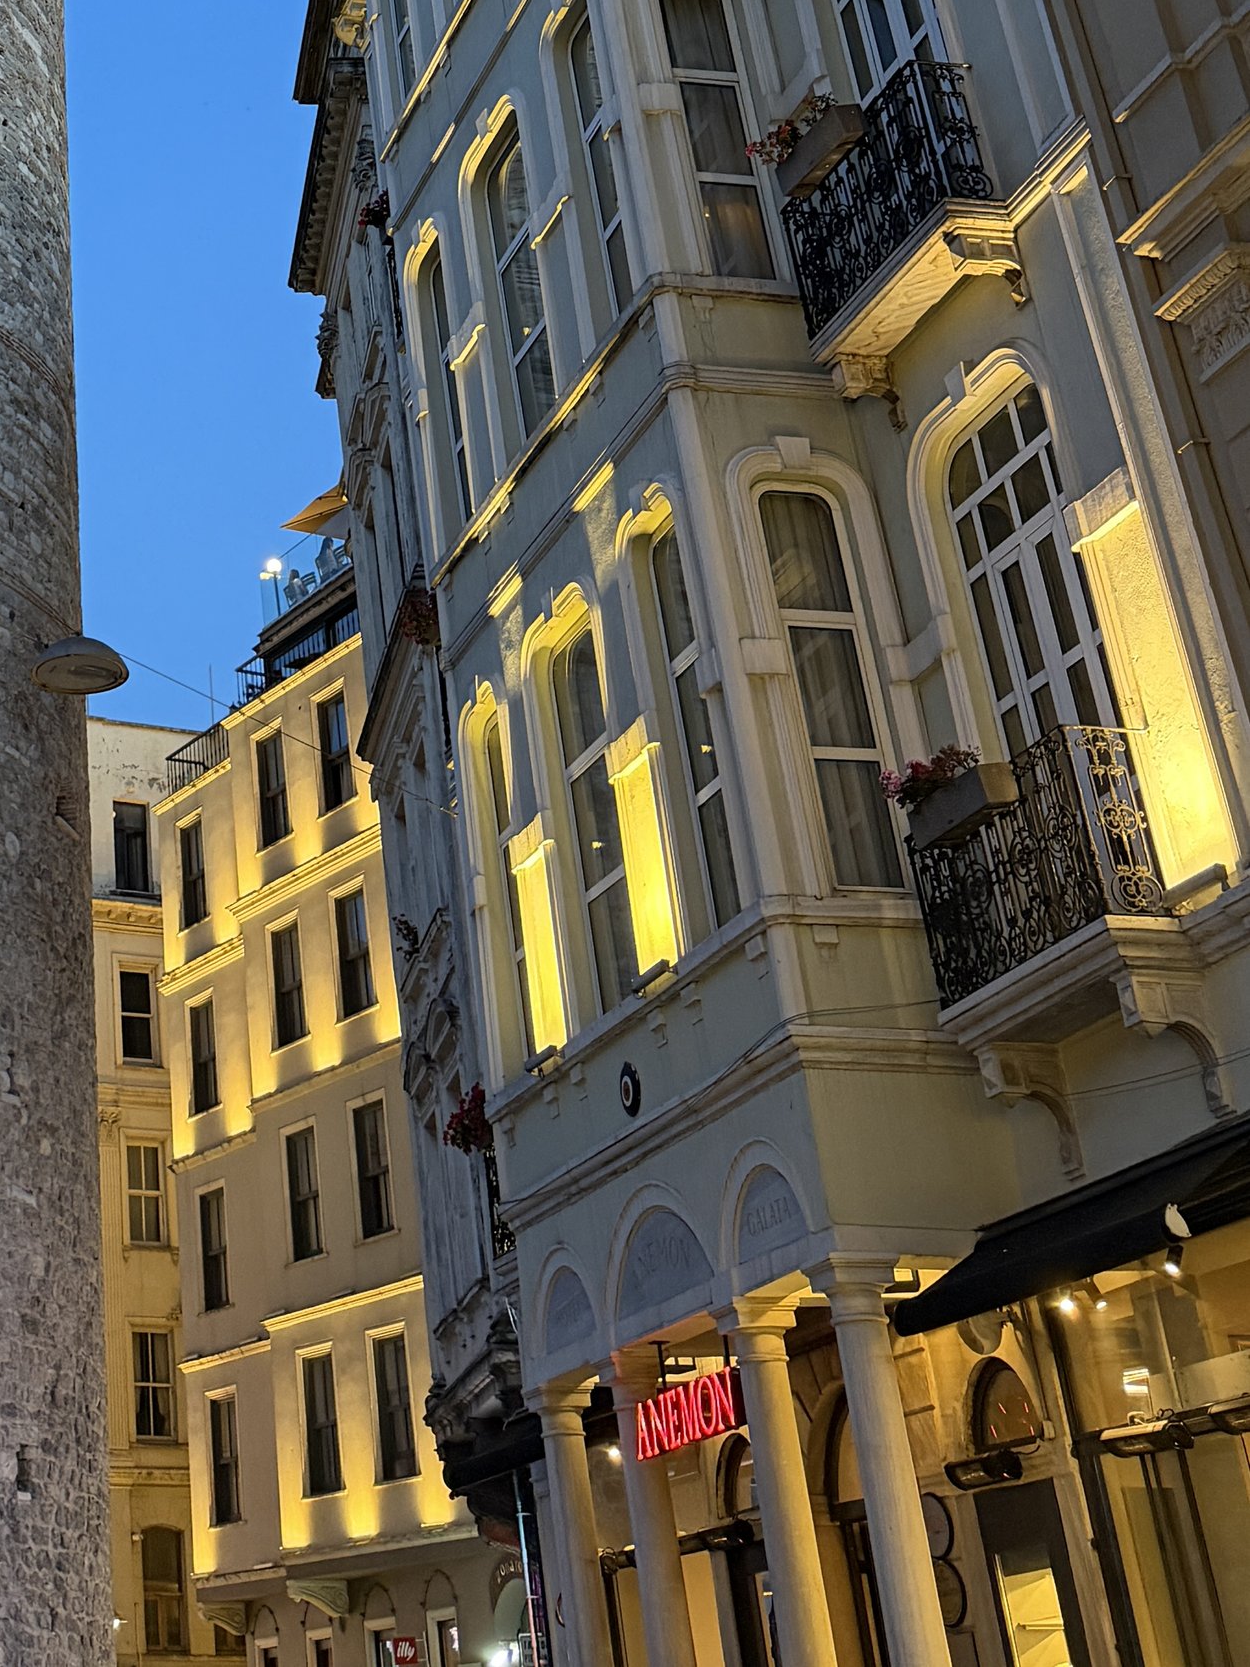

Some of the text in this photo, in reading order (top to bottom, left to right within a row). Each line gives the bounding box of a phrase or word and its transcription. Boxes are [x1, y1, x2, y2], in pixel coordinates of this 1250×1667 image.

[746, 1196, 792, 1237] GALATA
[636, 1366, 736, 1461] ANEMON
[397, 1641, 415, 1661] illy
